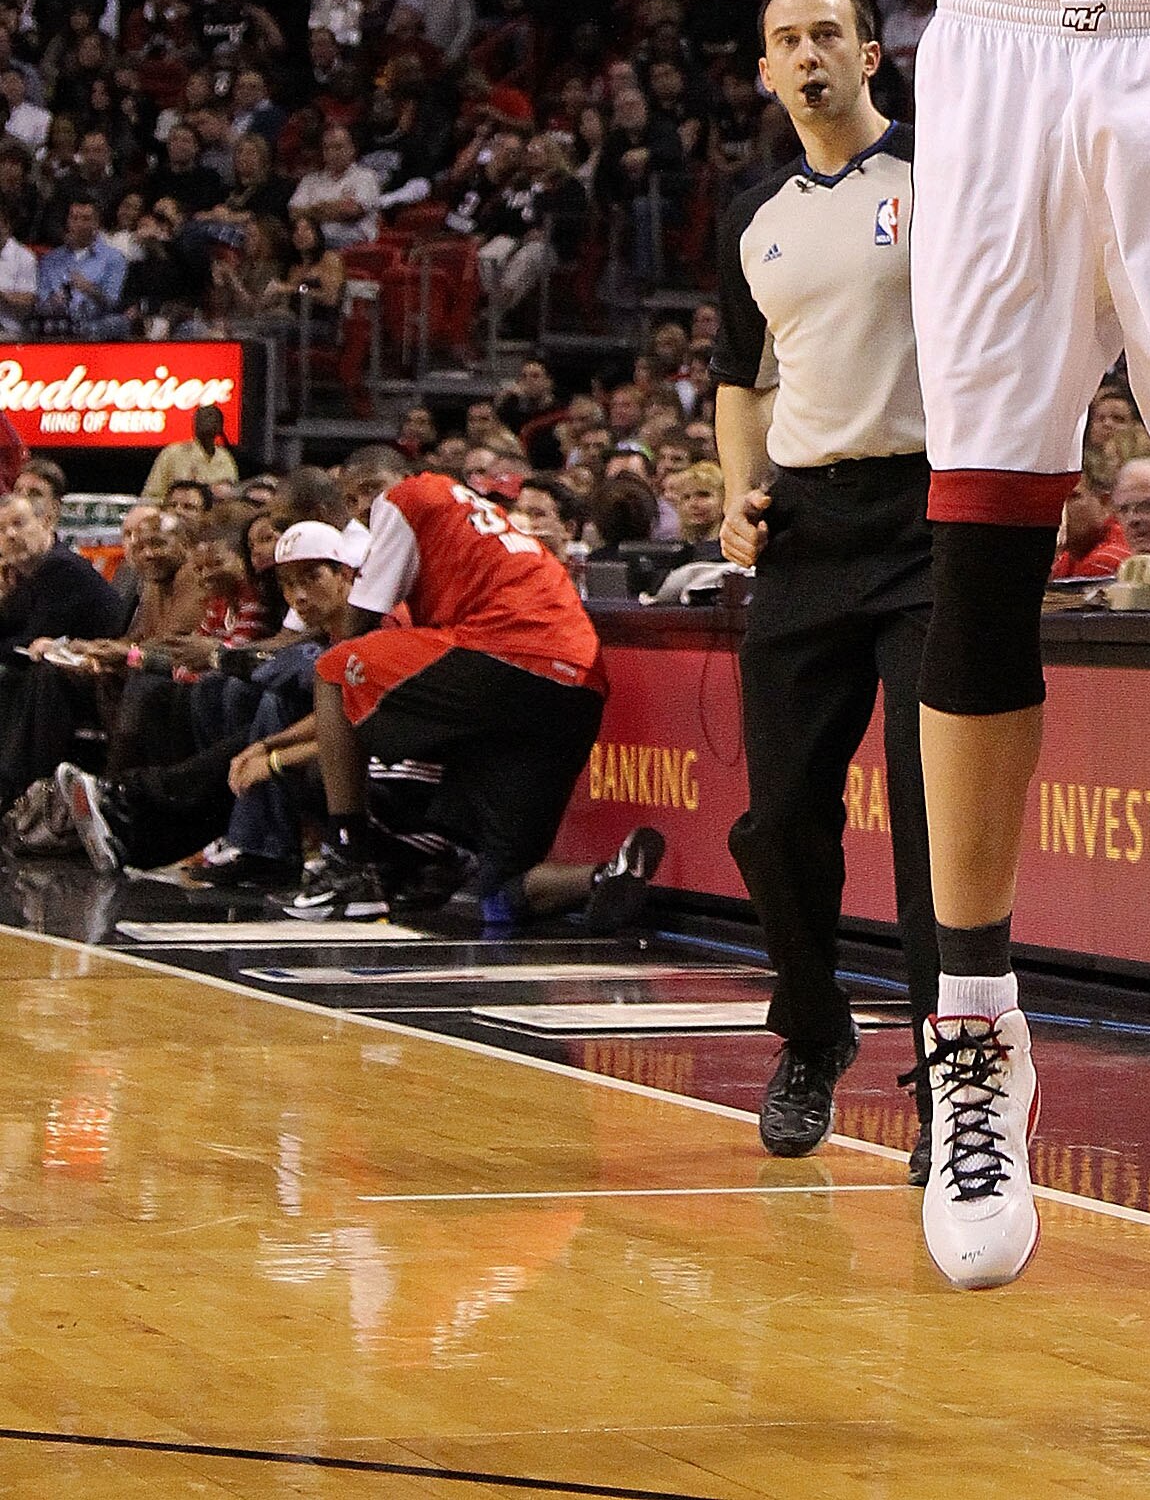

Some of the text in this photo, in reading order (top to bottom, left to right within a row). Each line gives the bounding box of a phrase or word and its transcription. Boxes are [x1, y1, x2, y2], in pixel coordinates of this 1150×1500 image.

[40, 410, 166, 433] KING OF BEERS
[590, 742, 699, 811] BANKING
